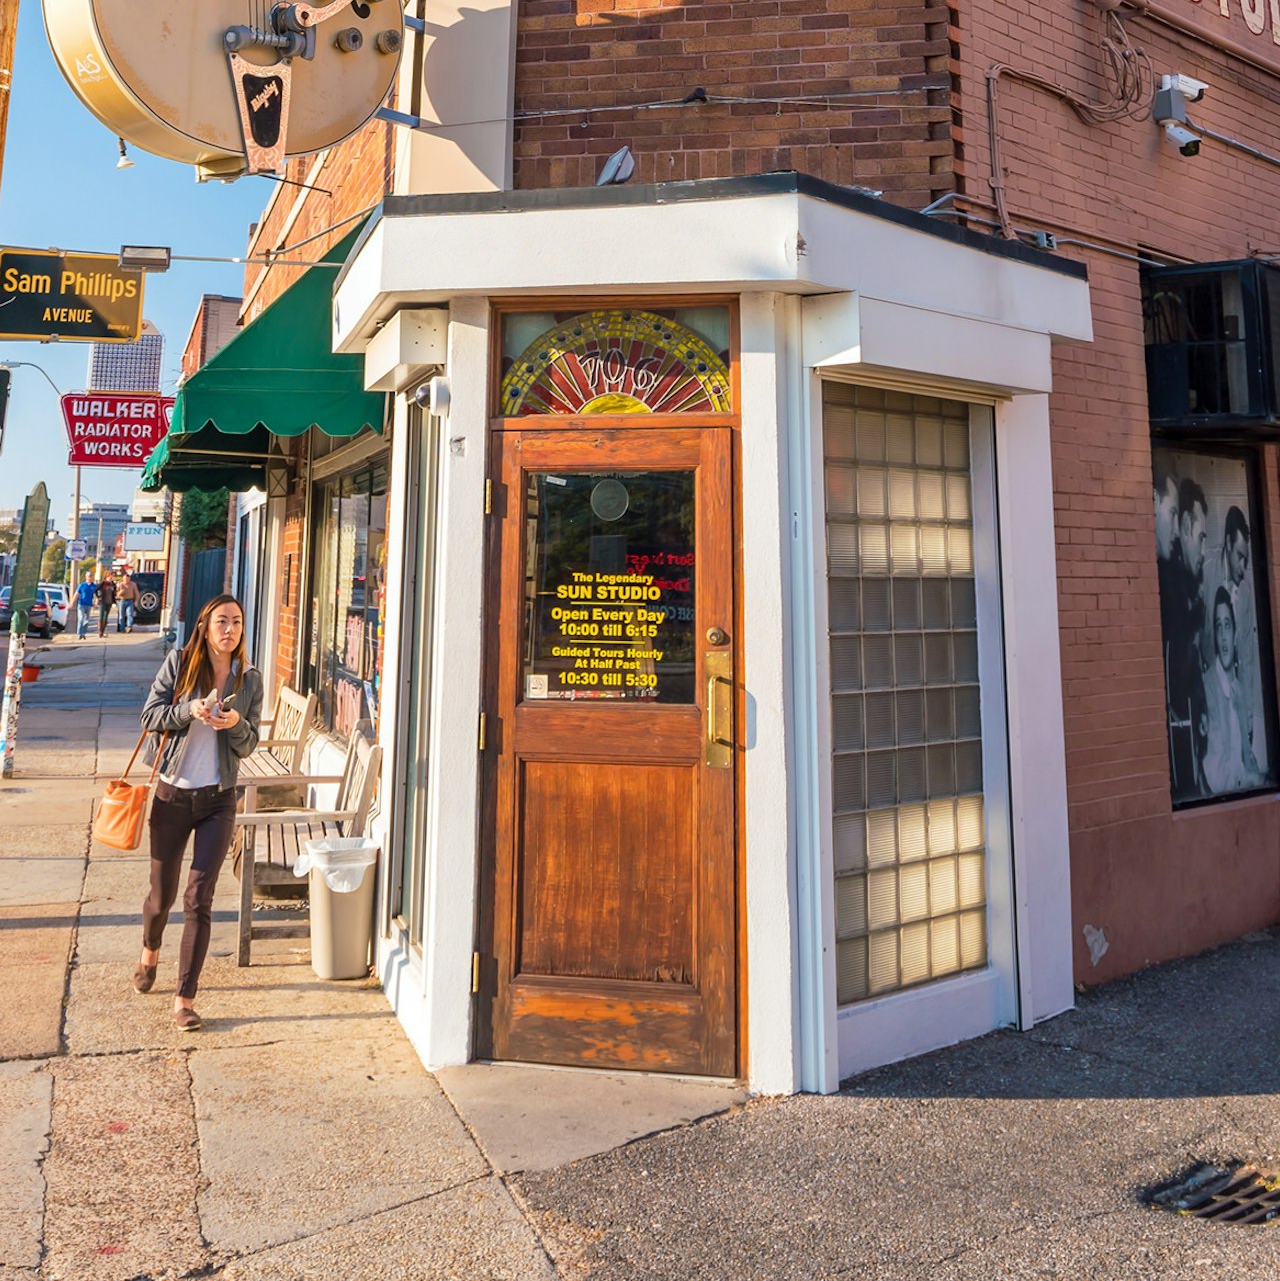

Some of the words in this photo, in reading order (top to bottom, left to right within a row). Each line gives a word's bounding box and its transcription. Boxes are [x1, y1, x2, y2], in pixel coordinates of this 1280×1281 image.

[3, 268, 51, 294] Sam
[60, 271, 137, 303] Phillips
[42, 307, 94, 323] AVENUE
[577, 348, 665, 389] 706
[73, 400, 156, 419] WALKER
[74, 423, 152, 438] RADIATOR
[84, 441, 143, 457] WORKS
[572, 572, 594, 583] The
[596, 572, 654, 586] Legendary
[556, 585, 593, 600] SUN
[597, 585, 661, 601] STUDIO
[551, 607, 591, 624] Open
[592, 608, 634, 624] Every
[637, 609, 665, 624] Day
[559, 623, 599, 636] 10:00
[602, 623, 622, 636] till
[625, 624, 658, 637] 6:15
[551, 647, 591, 658] Guided
[592, 647, 625, 658] Tours
[627, 648, 663, 661] Hourly
[574, 659, 589, 669] At
[590, 659, 613, 670] Half
[616, 659, 641, 670] Past
[558, 672, 599, 685] 10:30
[602, 672, 622, 686] till
[625, 673, 658, 687] 5:30
